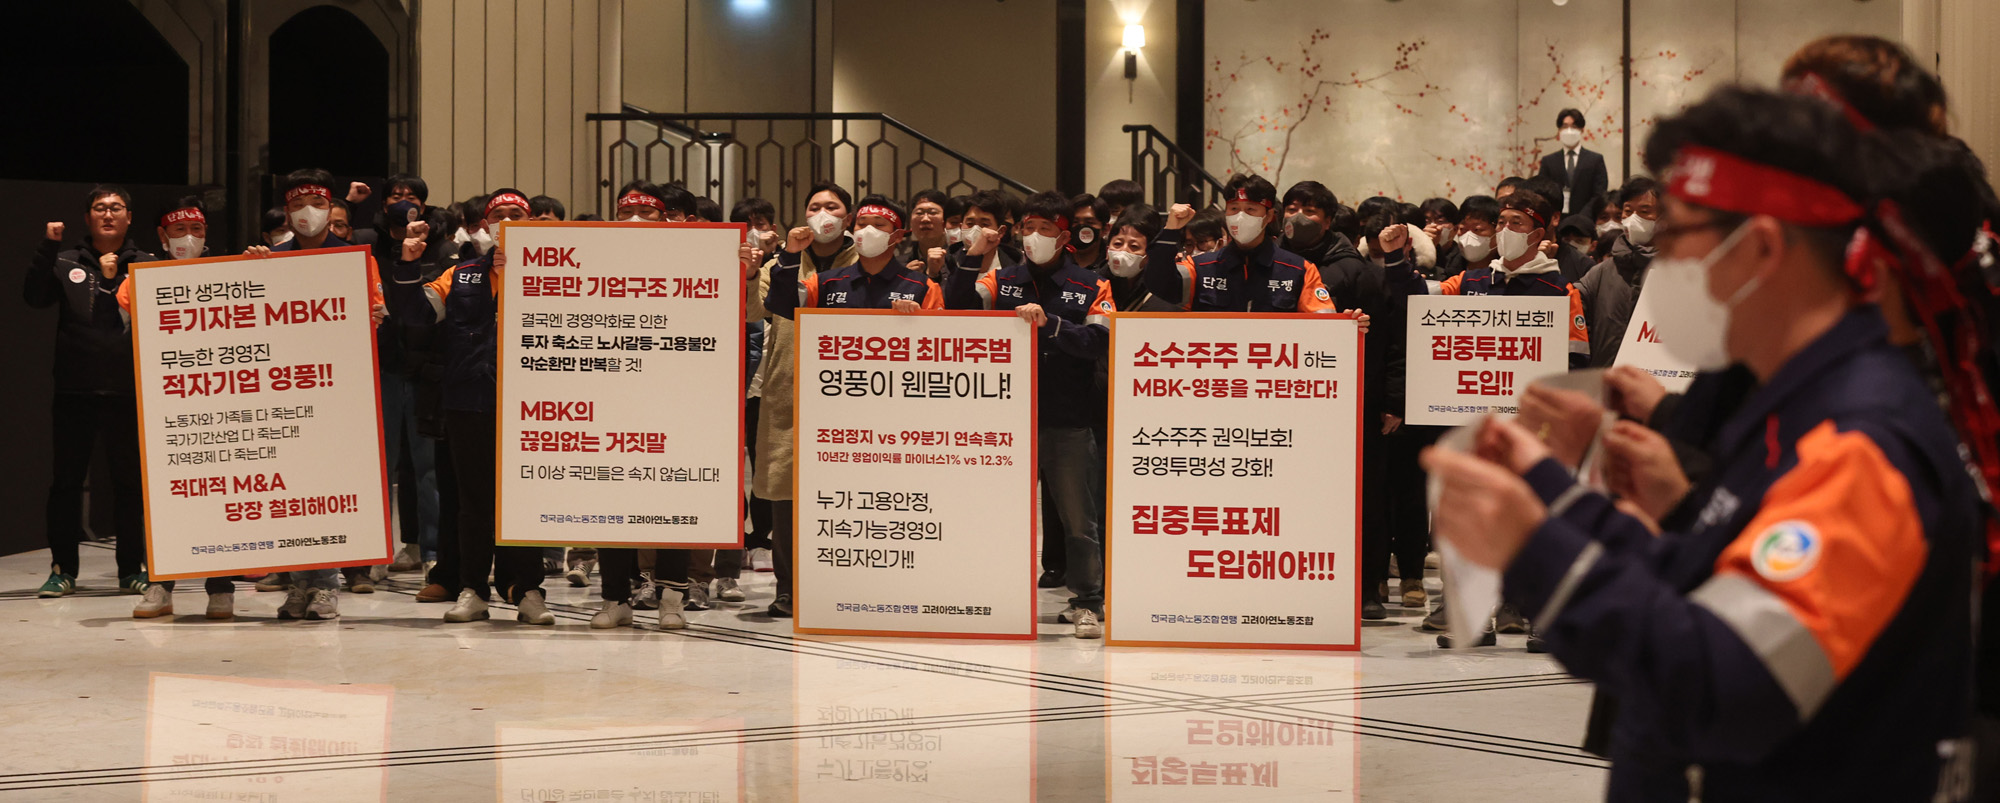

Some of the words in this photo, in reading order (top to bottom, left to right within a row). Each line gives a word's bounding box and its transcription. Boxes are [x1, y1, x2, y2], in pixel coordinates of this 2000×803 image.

[523, 247, 580, 269] MBK,
[458, 273, 482, 284] 단결
[523, 276, 582, 297] 말로만
[588, 277, 667, 298] 기업구조
[673, 278, 719, 298] 개선!
[1203, 276, 1227, 290] 단결
[1267, 280, 1293, 292] 투쟁
[156, 286, 191, 305] 돈만
[195, 281, 265, 302] 생각하는
[826, 292, 847, 305] 단결
[1000, 284, 1023, 298] 단결
[1060, 291, 1087, 305] 투쟁
[159, 304, 256, 334] 투기자본
[265, 297, 346, 326] MBK!!
[522, 313, 562, 328] 결국엔
[567, 314, 635, 328] 경영악화로
[640, 315, 668, 329] 인한
[1421, 310, 1511, 327] 소수주주가치
[1516, 310, 1553, 327] 보호!!
[521, 335, 549, 349] 투자
[552, 335, 593, 349] 축소로
[597, 336, 716, 351] 노사갈등-고용불안
[818, 335, 909, 361] 환경오염
[917, 337, 1011, 363] 최대주범
[1432, 336, 1541, 362] 집중투표제
[161, 348, 214, 369] 무능한
[218, 343, 270, 364] 경영진
[521, 357, 576, 371] 악순환만
[580, 357, 622, 372] 반복할
[625, 358, 641, 372] 것!
[1134, 342, 1238, 369] 소수주주
[1247, 343, 1298, 369] 무시
[1304, 351, 1337, 368] 하는
[163, 369, 260, 398] 적자기업
[269, 364, 333, 391] 영풍!!
[819, 370, 892, 397] 영풍이
[902, 371, 1011, 399] 웬말이냐!
[1134, 379, 1248, 398] MBK-영풍을
[1255, 380, 1337, 399] 규탄한다!
[1457, 371, 1513, 396] 도입!!
[165, 413, 214, 428] 노동자와
[217, 410, 253, 424] 가족들
[256, 409, 268, 421] 다
[271, 406, 313, 420] 죽는다!!
[521, 401, 593, 422] MBK의
[166, 430, 238, 446] 국가기간산업
[242, 429, 254, 441] 다
[257, 426, 299, 439] 죽는다!!
[520, 431, 600, 452] 끊임없는
[606, 432, 666, 453] 거짓말
[817, 429, 872, 444] 조업정지
[878, 434, 896, 444] vs
[901, 431, 948, 446] 99분기
[954, 432, 1013, 447] 연속흑자
[1132, 427, 1207, 447] 소수주주
[1213, 428, 1292, 447] 권익보호!
[168, 451, 216, 465] 지역경제
[219, 450, 231, 462] 다
[234, 446, 276, 460] 죽는다!!
[817, 452, 849, 462] 10년간
[852, 452, 902, 463] 영업이익률
[905, 454, 960, 465] 마이너스1%
[980, 455, 1012, 466] 12.3%
[521, 465, 533, 479] 더
[538, 466, 566, 480] 이상
[569, 466, 624, 481] 국민들은
[628, 467, 655, 481] 속지
[660, 467, 719, 482] 않습니다!
[1133, 457, 1225, 476] 경영투명성
[1232, 458, 1272, 477] 강화!
[170, 476, 226, 498] 적대적
[233, 473, 286, 493] M&A
[225, 501, 263, 521] 당장
[269, 494, 358, 518] 철회해야!!
[817, 491, 853, 509] 누가
[857, 492, 932, 513] 고용안정,
[628, 515, 698, 525] 고려아연노동조합
[817, 519, 941, 541] 지속가능경영의
[1132, 506, 1279, 536] 집중투표제
[278, 535, 346, 548] 고려아연노동조합
[817, 548, 914, 568] 적임자인가!!
[1187, 550, 1335, 580] 도입해야!!!
[922, 605, 991, 615] 고려아연노동조합
[1241, 616, 1314, 625] 고려아연노동조합
